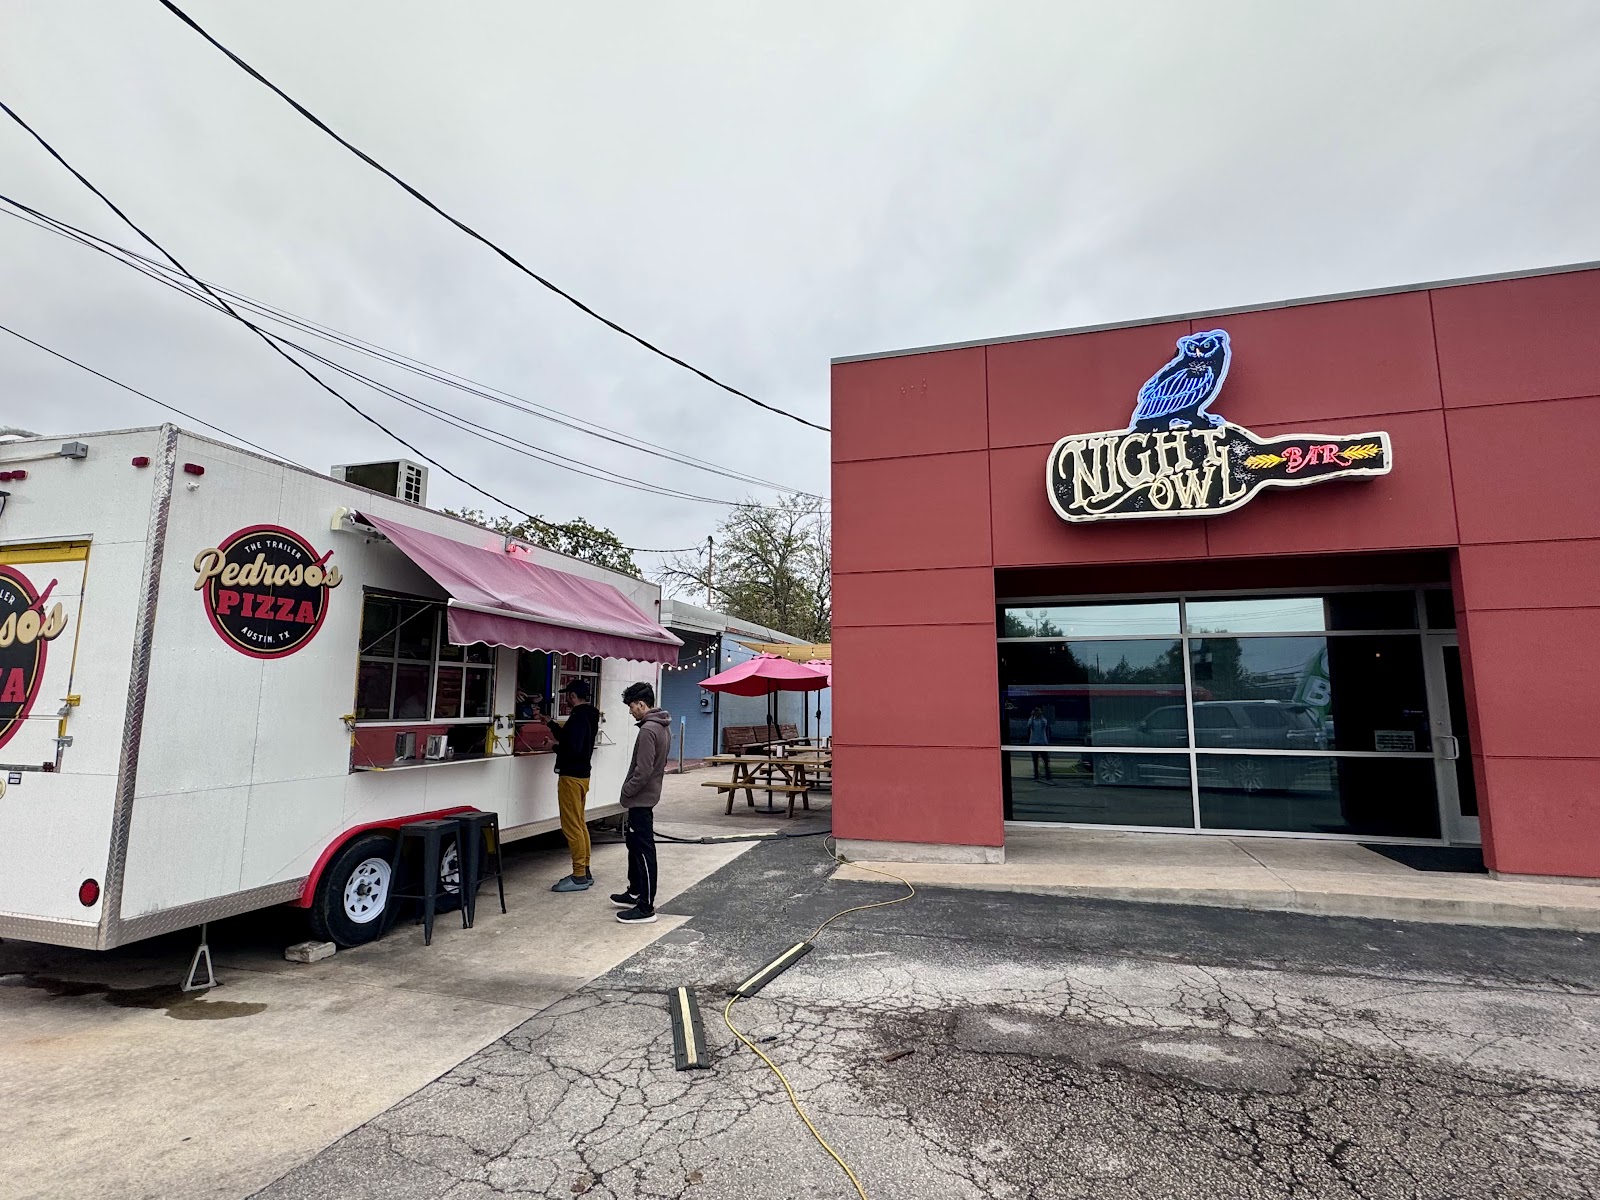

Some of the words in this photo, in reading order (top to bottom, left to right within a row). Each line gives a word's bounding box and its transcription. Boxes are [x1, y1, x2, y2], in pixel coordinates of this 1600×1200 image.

[1058, 425, 1228, 512] NIGHT
[1281, 444, 1352, 474] BAR
[1149, 445, 1247, 510] OWL
[244, 541, 262, 554] THE
[266, 540, 302, 560] TRAILER
[216, 589, 316, 624] PIZZA
[278, 630, 291, 641] TX
